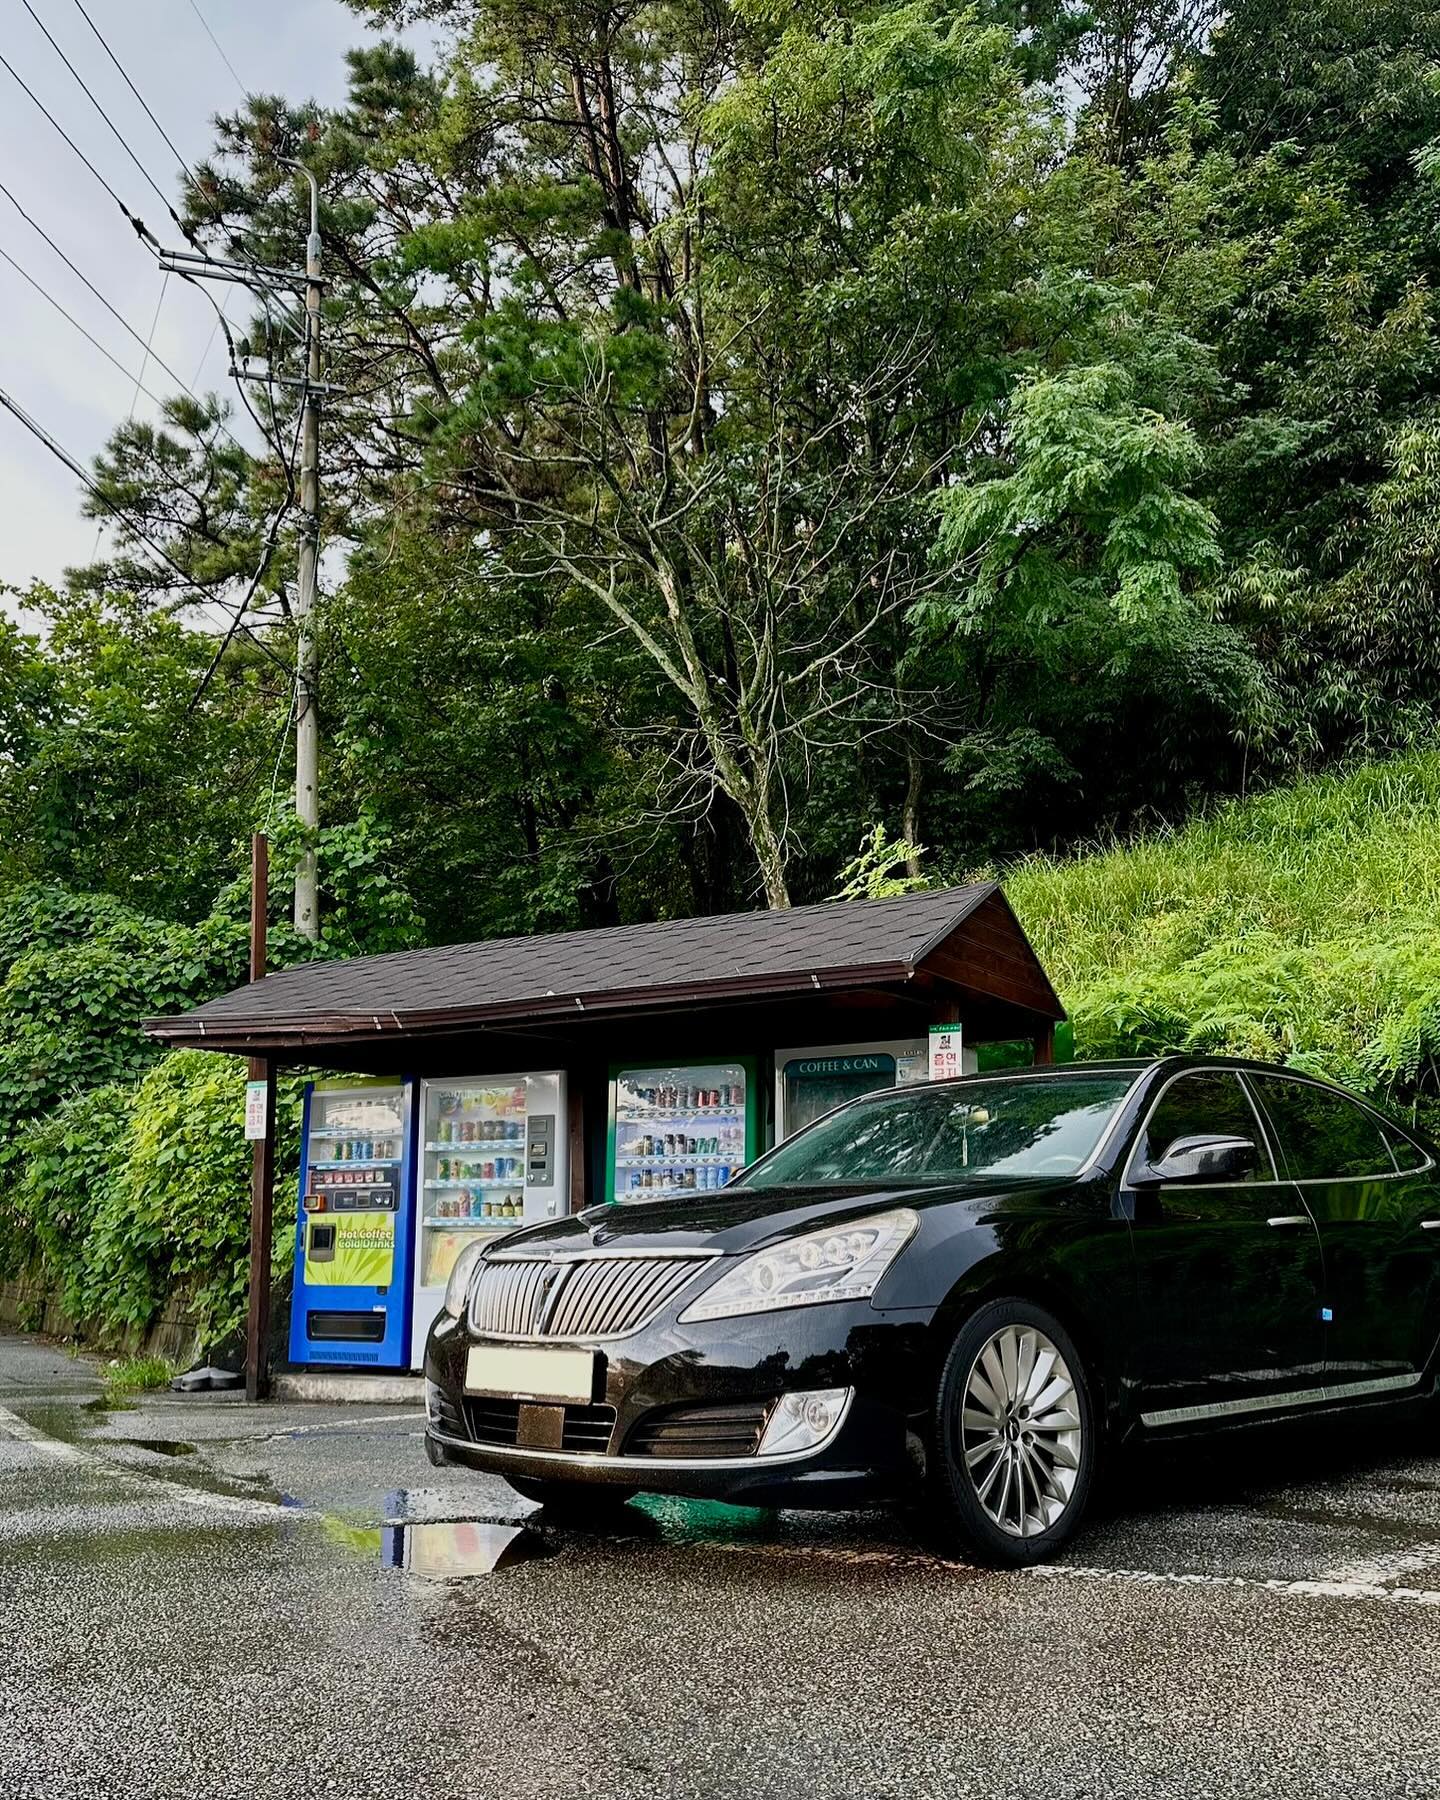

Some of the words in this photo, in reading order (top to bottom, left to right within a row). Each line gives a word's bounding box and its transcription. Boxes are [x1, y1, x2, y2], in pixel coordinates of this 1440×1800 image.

[934, 1053, 957, 1066] 흡연
[799, 1061, 839, 1073] COFFEE
[842, 1061, 851, 1070] &
[853, 1059, 878, 1070] CAN
[934, 1068, 957, 1080] 금지
[338, 1229, 357, 1239] Hot
[359, 1228, 392, 1239] Coffee
[338, 1239, 360, 1249] Cold
[362, 1239, 395, 1249] Drinks
